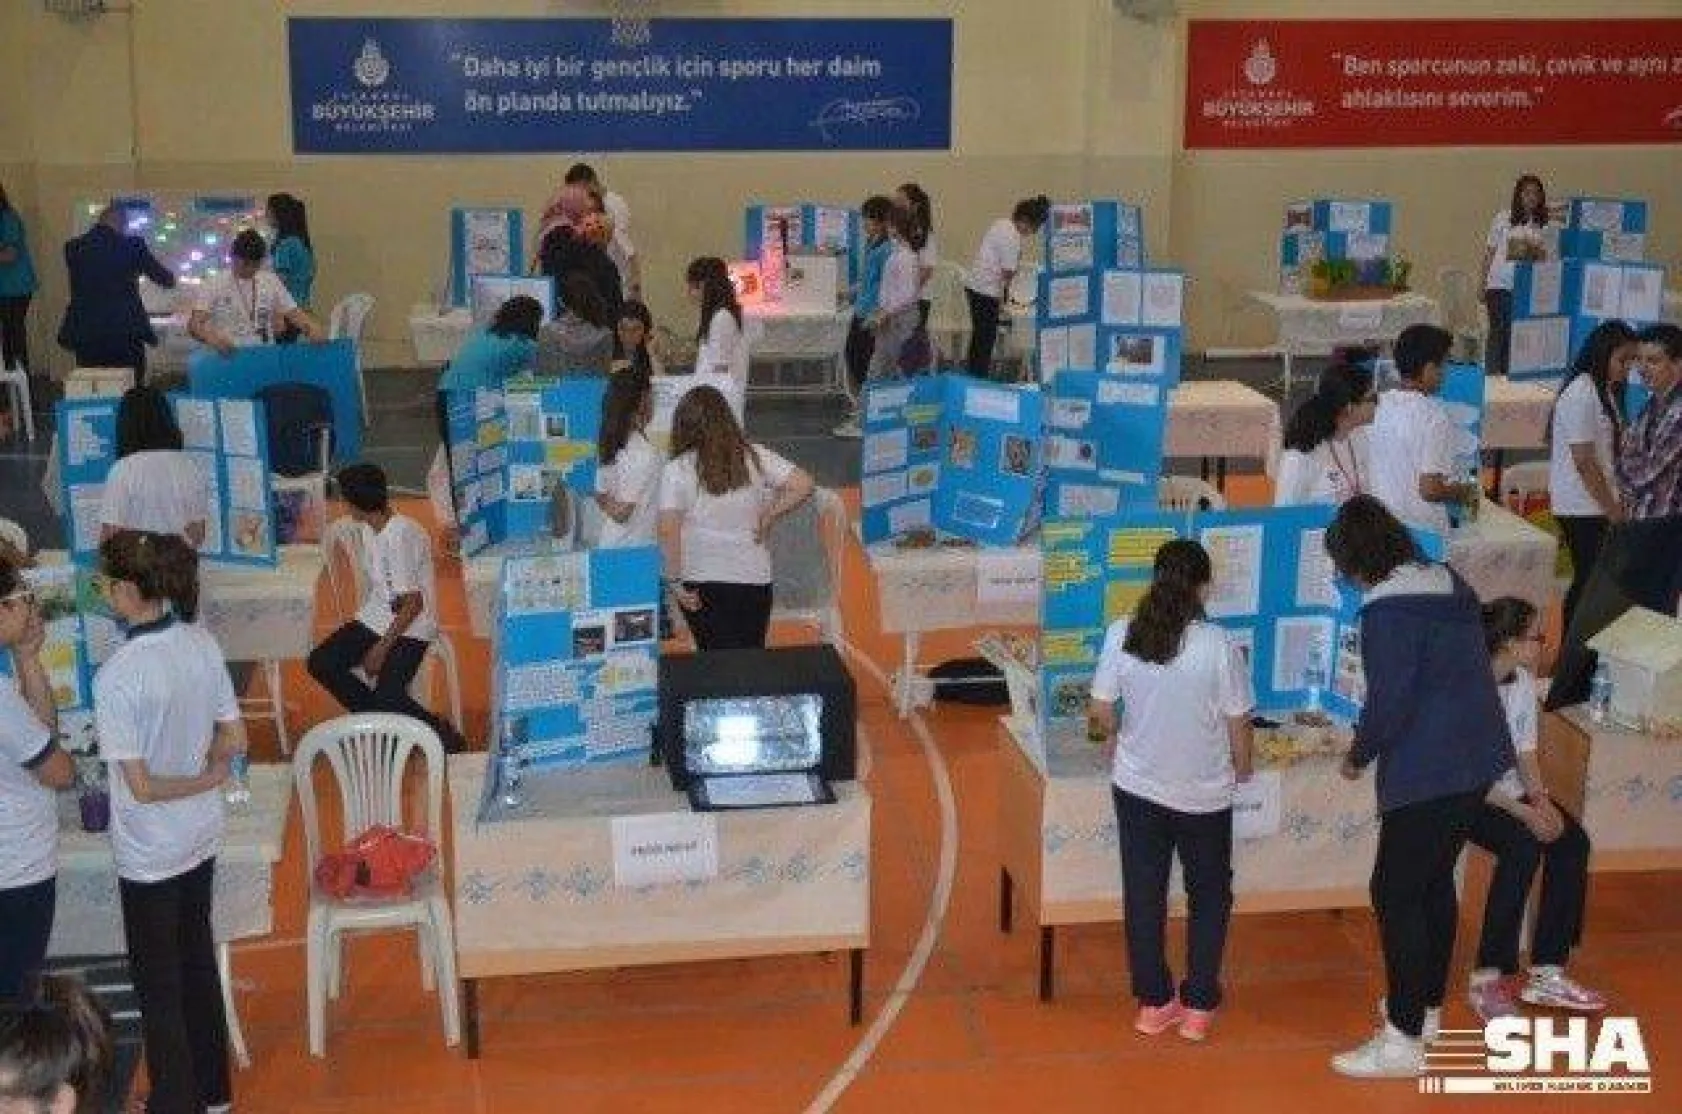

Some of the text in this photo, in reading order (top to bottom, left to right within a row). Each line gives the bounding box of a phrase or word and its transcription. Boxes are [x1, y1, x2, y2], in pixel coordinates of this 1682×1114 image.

[556, 56, 584, 77] bir
[719, 58, 781, 80] sporu
[786, 56, 820, 77] her
[827, 56, 882, 77] daim
[1602, 57, 1622, 73] ve
[497, 90, 572, 115] planda
